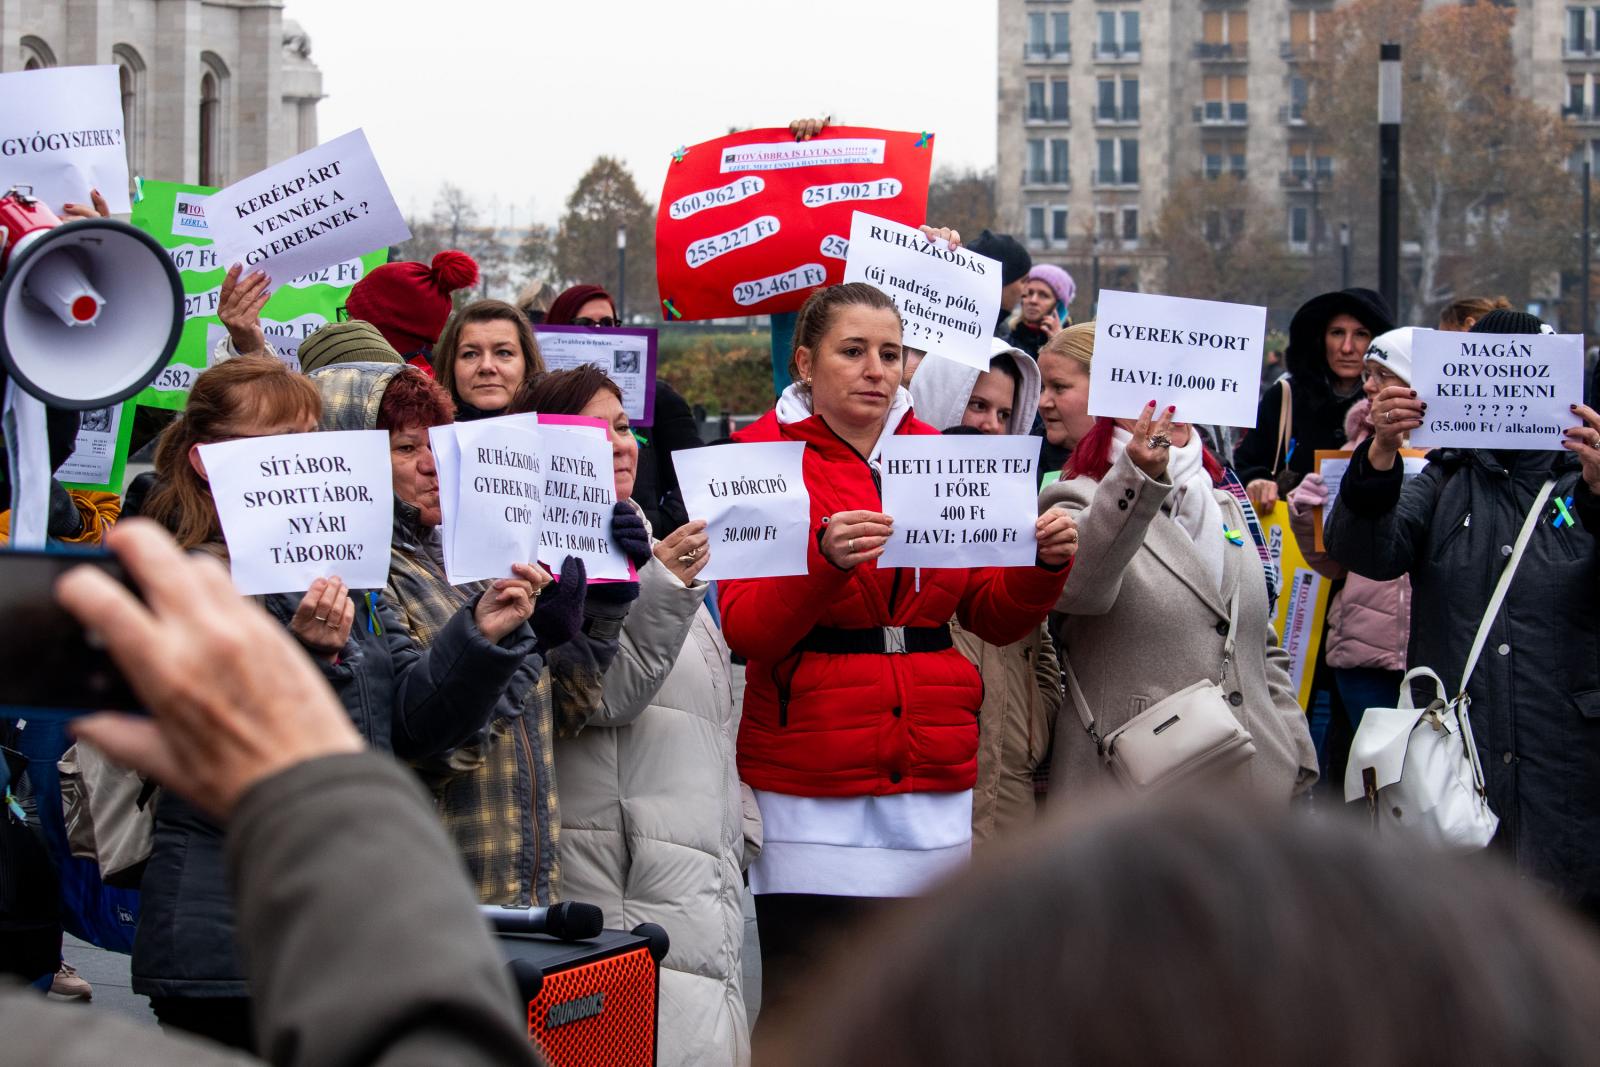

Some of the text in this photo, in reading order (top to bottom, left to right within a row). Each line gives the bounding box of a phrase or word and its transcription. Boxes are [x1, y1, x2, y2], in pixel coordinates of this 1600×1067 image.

[2, 129, 115, 156] GYÓGYSZEREK
[235, 161, 342, 219] KERÉKPÁRT
[672, 180, 760, 217] 360.962 Ft
[804, 181, 897, 204] 251.902 Ft
[253, 190, 345, 236] VENNÉK A
[246, 201, 369, 266] GYEREKNEK ?
[688, 220, 775, 265] 255.227 Ft
[199, 250, 218, 267] Ft
[870, 225, 985, 276] RUHÁZKODÁS
[337, 263, 358, 281] Ft
[734, 267, 824, 303] 292.467 Ft
[864, 264, 885, 282] (új
[889, 273, 941, 305] nadrág,
[945, 294, 979, 317] póló,
[208, 291, 219, 310] F
[903, 298, 982, 340] fehérnemű)
[913, 322, 920, 336] ?
[925, 327, 931, 340] ?
[936, 331, 944, 344] ?
[1107, 323, 1250, 351] GYEREK SPORT
[1460, 340, 1532, 358] MAGÁN
[1110, 367, 1239, 393] HAVI: 10.000 Ft
[1442, 362, 1550, 378] ORVOSHOZ
[1436, 383, 1555, 398] KELL MENNI
[1464, 403, 1528, 418] ? ? ? ? ?
[1430, 420, 1561, 437] (35.000 Ft / alkalom)
[260, 454, 351, 477] SÍTÁBOR,
[477, 446, 540, 474] RUHÁZKODÁS
[551, 455, 597, 480] KENYÉR,
[887, 458, 1033, 475] HETI 1 LITER TEJ
[243, 481, 374, 509] SPORTTÁBOR,
[474, 476, 523, 497] GYEREK
[544, 480, 611, 505] EMLE, KIFLI
[708, 474, 787, 498] ÚJ BŐRCIPŐ
[934, 477, 990, 498] 1 FŐRE
[288, 512, 347, 535] NYÁRI
[572, 509, 589, 527] 670
[591, 513, 602, 529] Ft
[940, 505, 985, 521] 400 Ft
[539, 530, 609, 554] AVI: 18.000 Ft
[722, 525, 778, 543] 30.000 Ft
[905, 528, 1017, 544] HAVI: 1.600 Ft
[270, 542, 364, 564] TÁBOROK?
